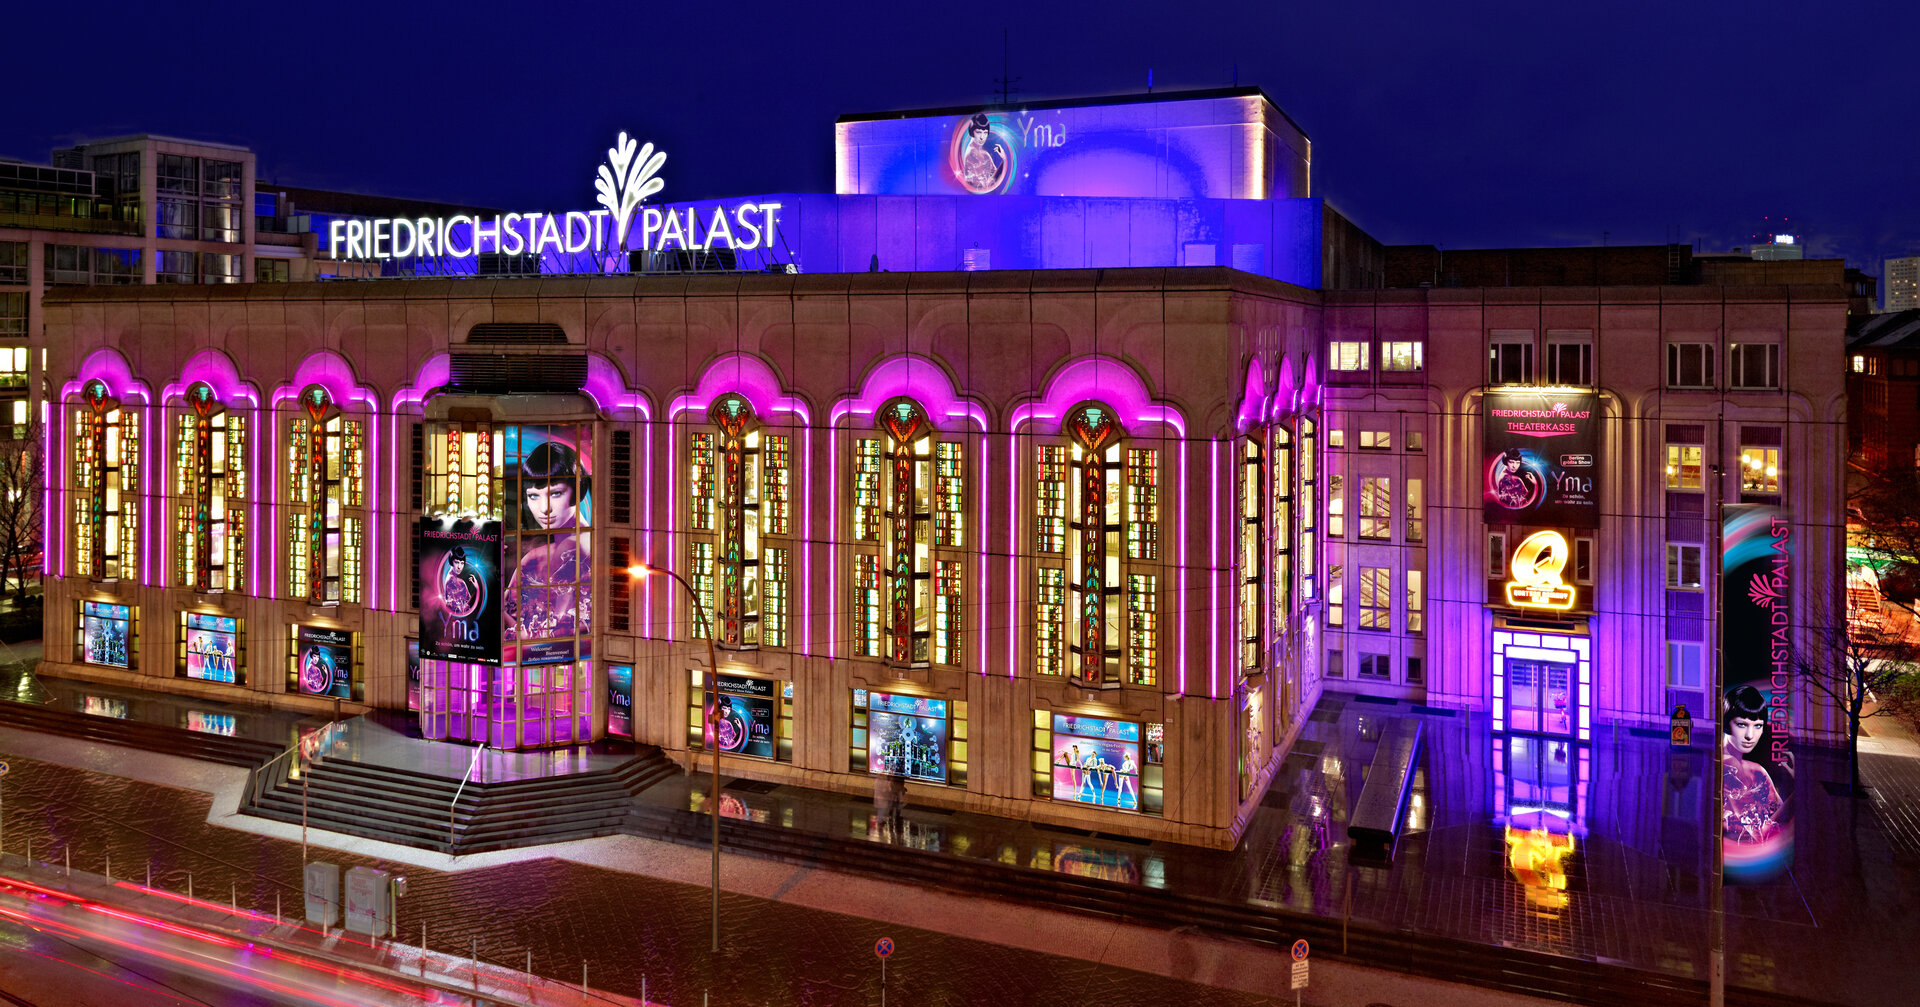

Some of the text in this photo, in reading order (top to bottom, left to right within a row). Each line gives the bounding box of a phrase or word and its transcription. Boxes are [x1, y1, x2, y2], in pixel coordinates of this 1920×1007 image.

[1016, 117, 1066, 148] Yma
[331, 203, 782, 259] FRIEDRICHSTADT PALAST
[1491, 409, 1590, 419] FRIEDRICHSTADT PALAST
[1507, 422, 1575, 432] THEATERKASSE
[1551, 471, 1593, 493] Yma
[423, 530, 498, 542] FRIEDRICHSTADT PALAST
[1771, 515, 1789, 588] PALAST
[438, 611, 479, 642] Yma
[1771, 602, 1789, 762] FRIEDRICHSTADT
[609, 689, 631, 707] Yma
[748, 719, 770, 735] Yma
[1062, 722, 1106, 733] FRIEDRICHSTADT
[1109, 727, 1130, 736] PALAST
